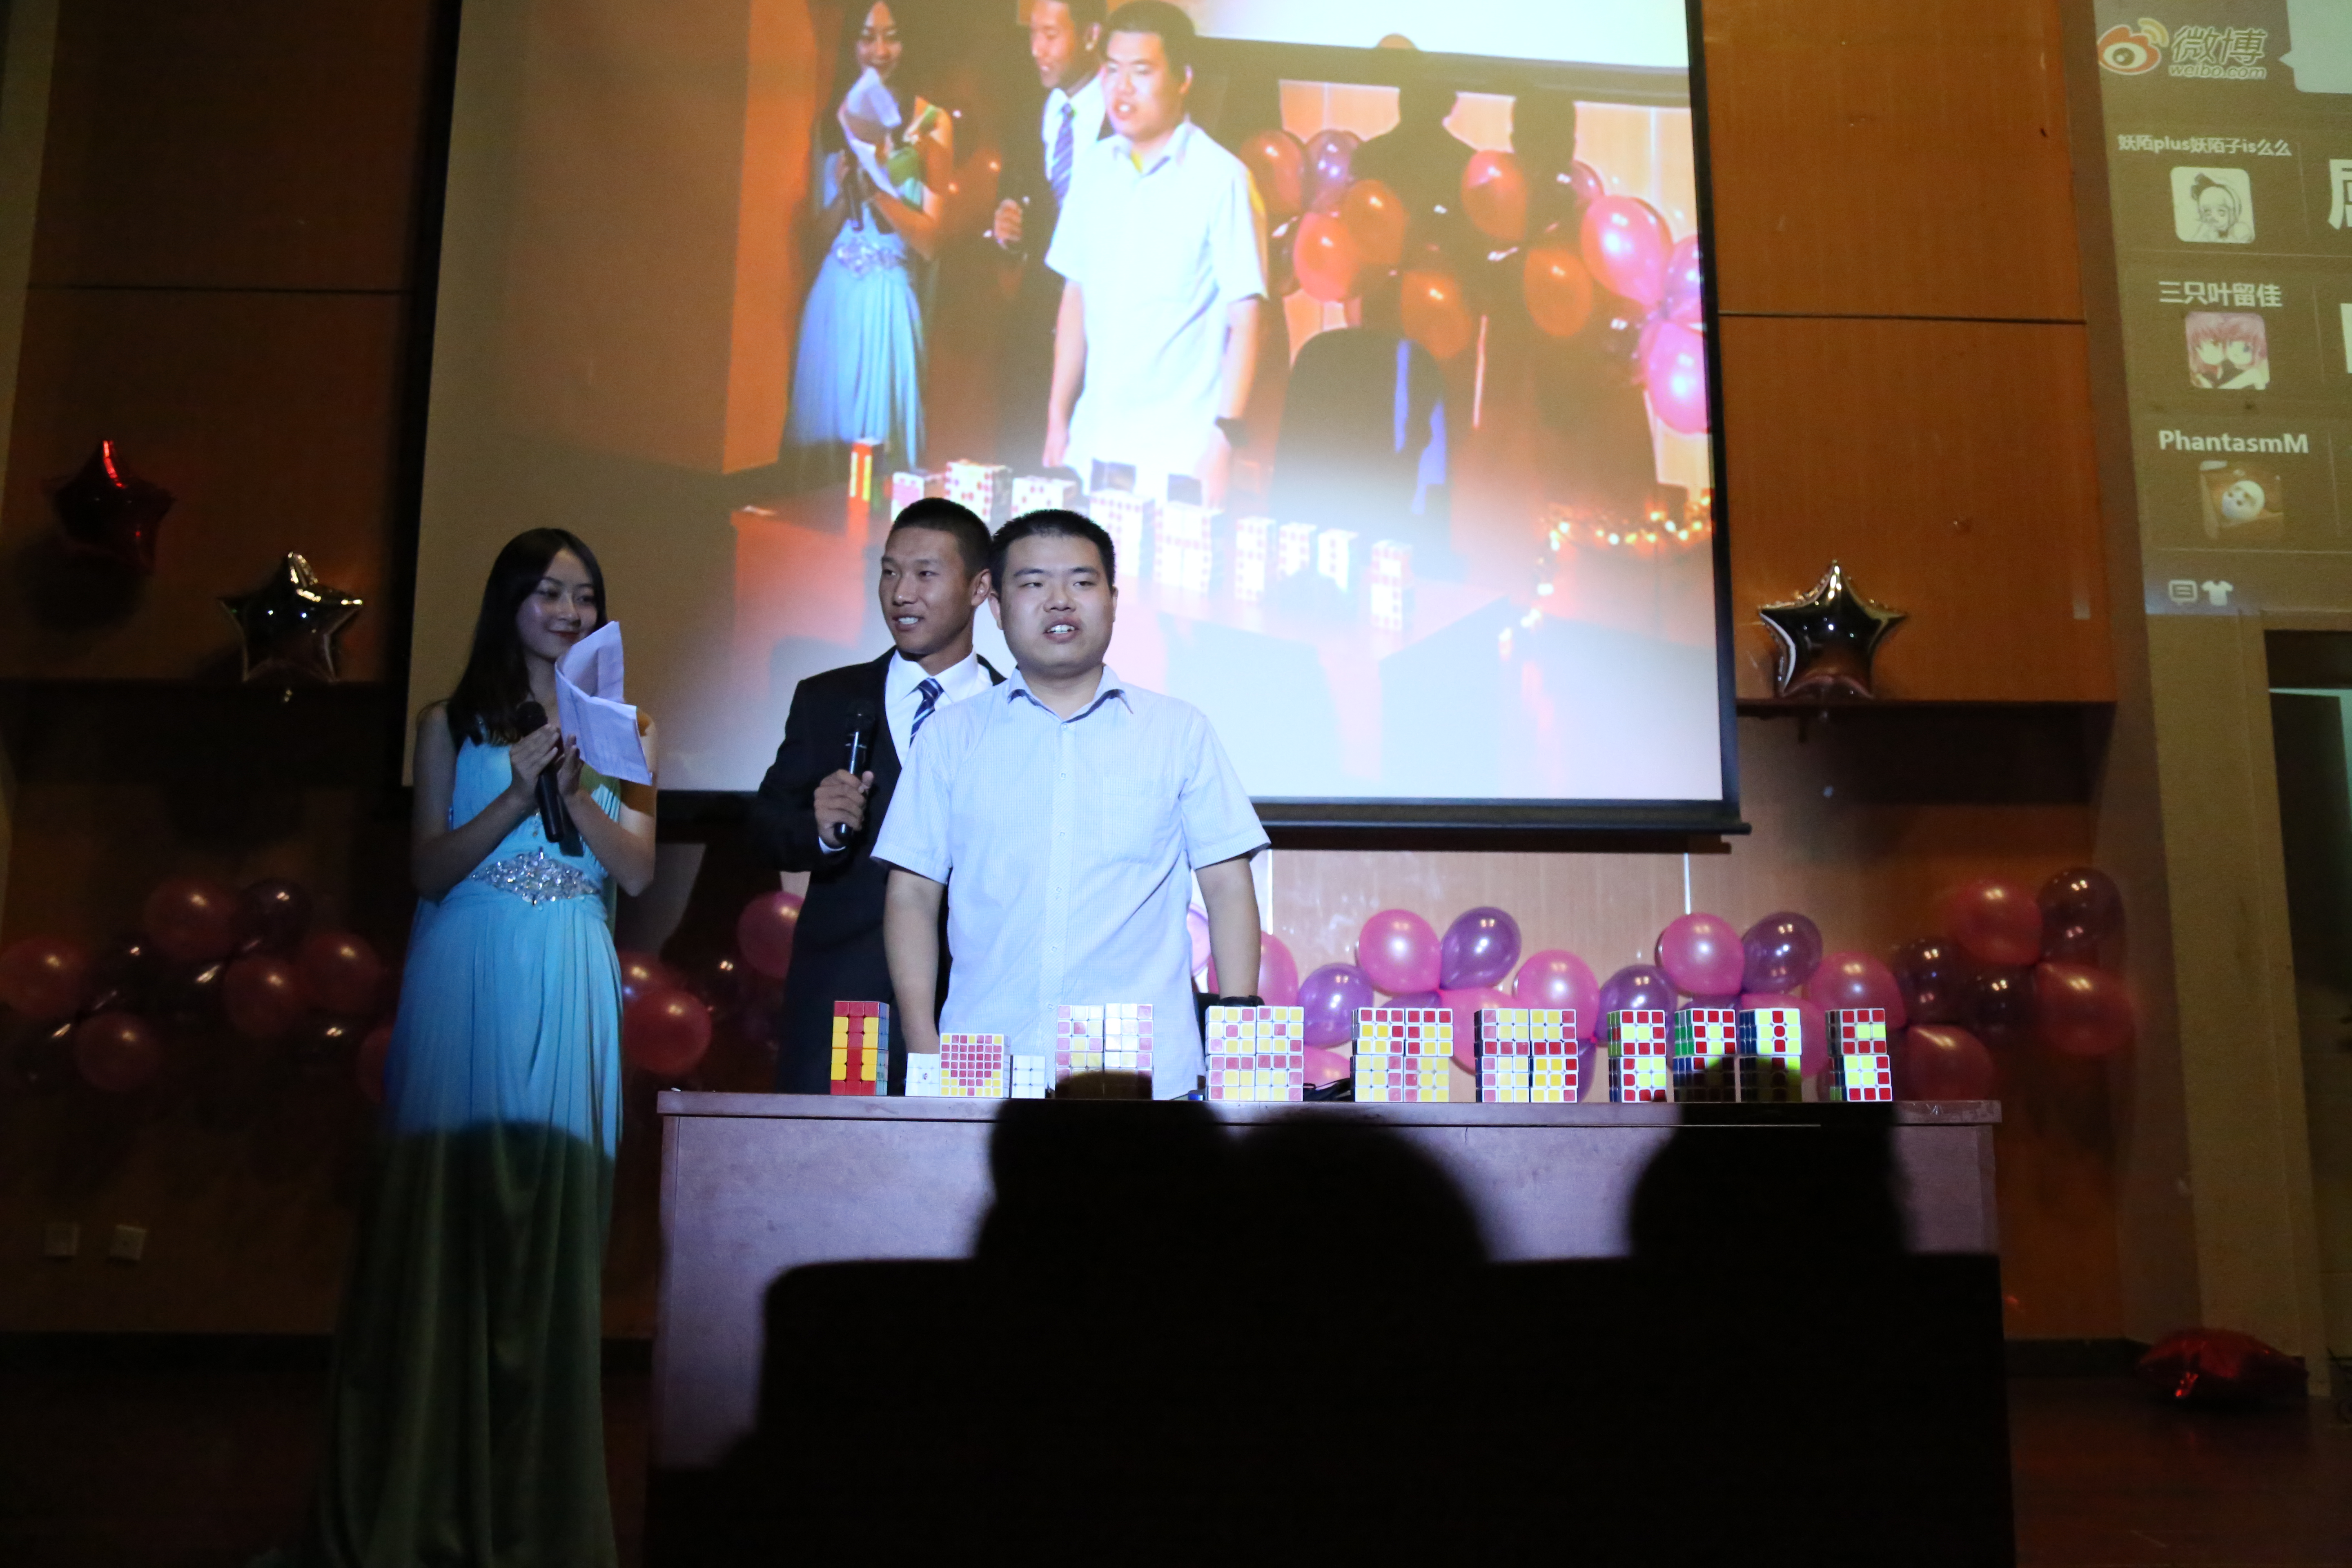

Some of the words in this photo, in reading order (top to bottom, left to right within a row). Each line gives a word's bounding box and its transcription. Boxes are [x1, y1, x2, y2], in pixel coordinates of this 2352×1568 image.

[2172, 25, 2267, 65] 微博
[2168, 62, 2267, 79] weibo.com
[2159, 281, 2283, 307] 三只叶留佳
[2159, 430, 2309, 453] PhantasmM
